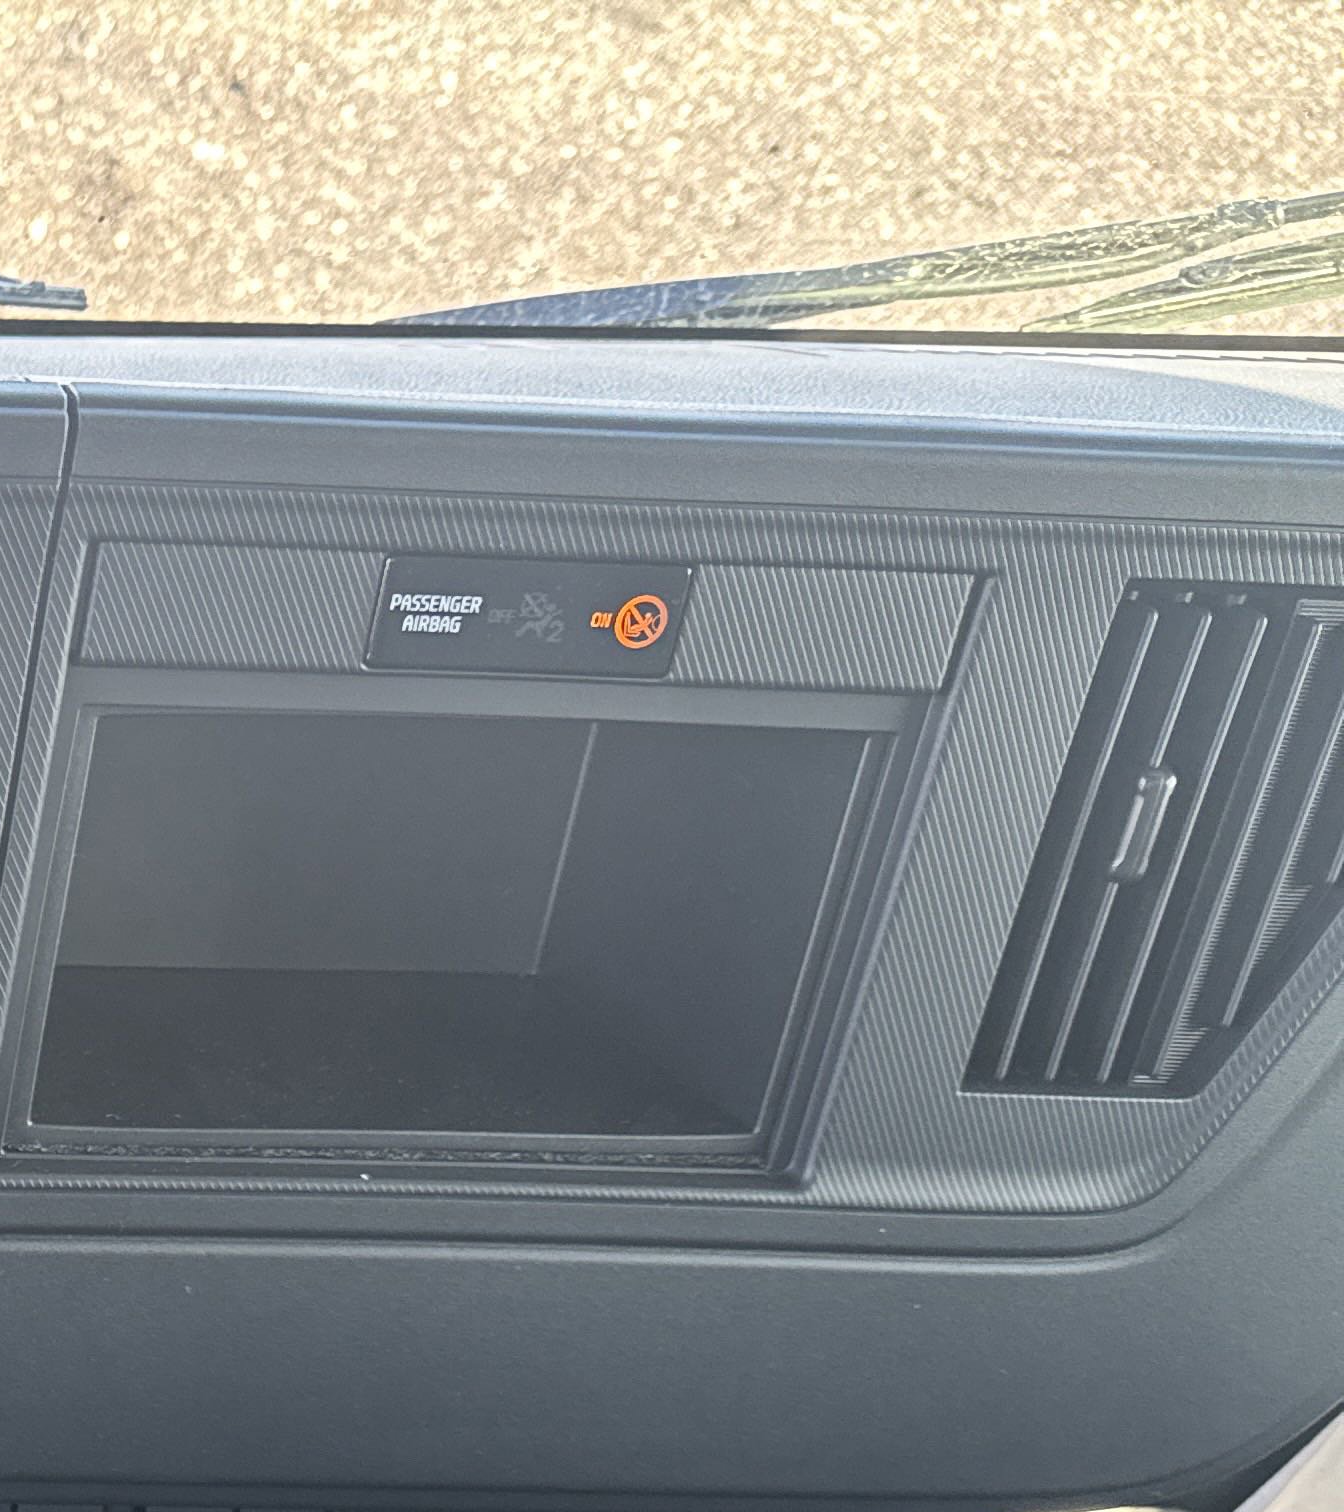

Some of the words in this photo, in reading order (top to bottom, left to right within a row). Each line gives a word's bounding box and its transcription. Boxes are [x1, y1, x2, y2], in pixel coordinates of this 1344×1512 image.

[389, 593, 483, 613] PASSENGER
[402, 614, 461, 633] AIRBAG
[590, 611, 612, 629] ON
